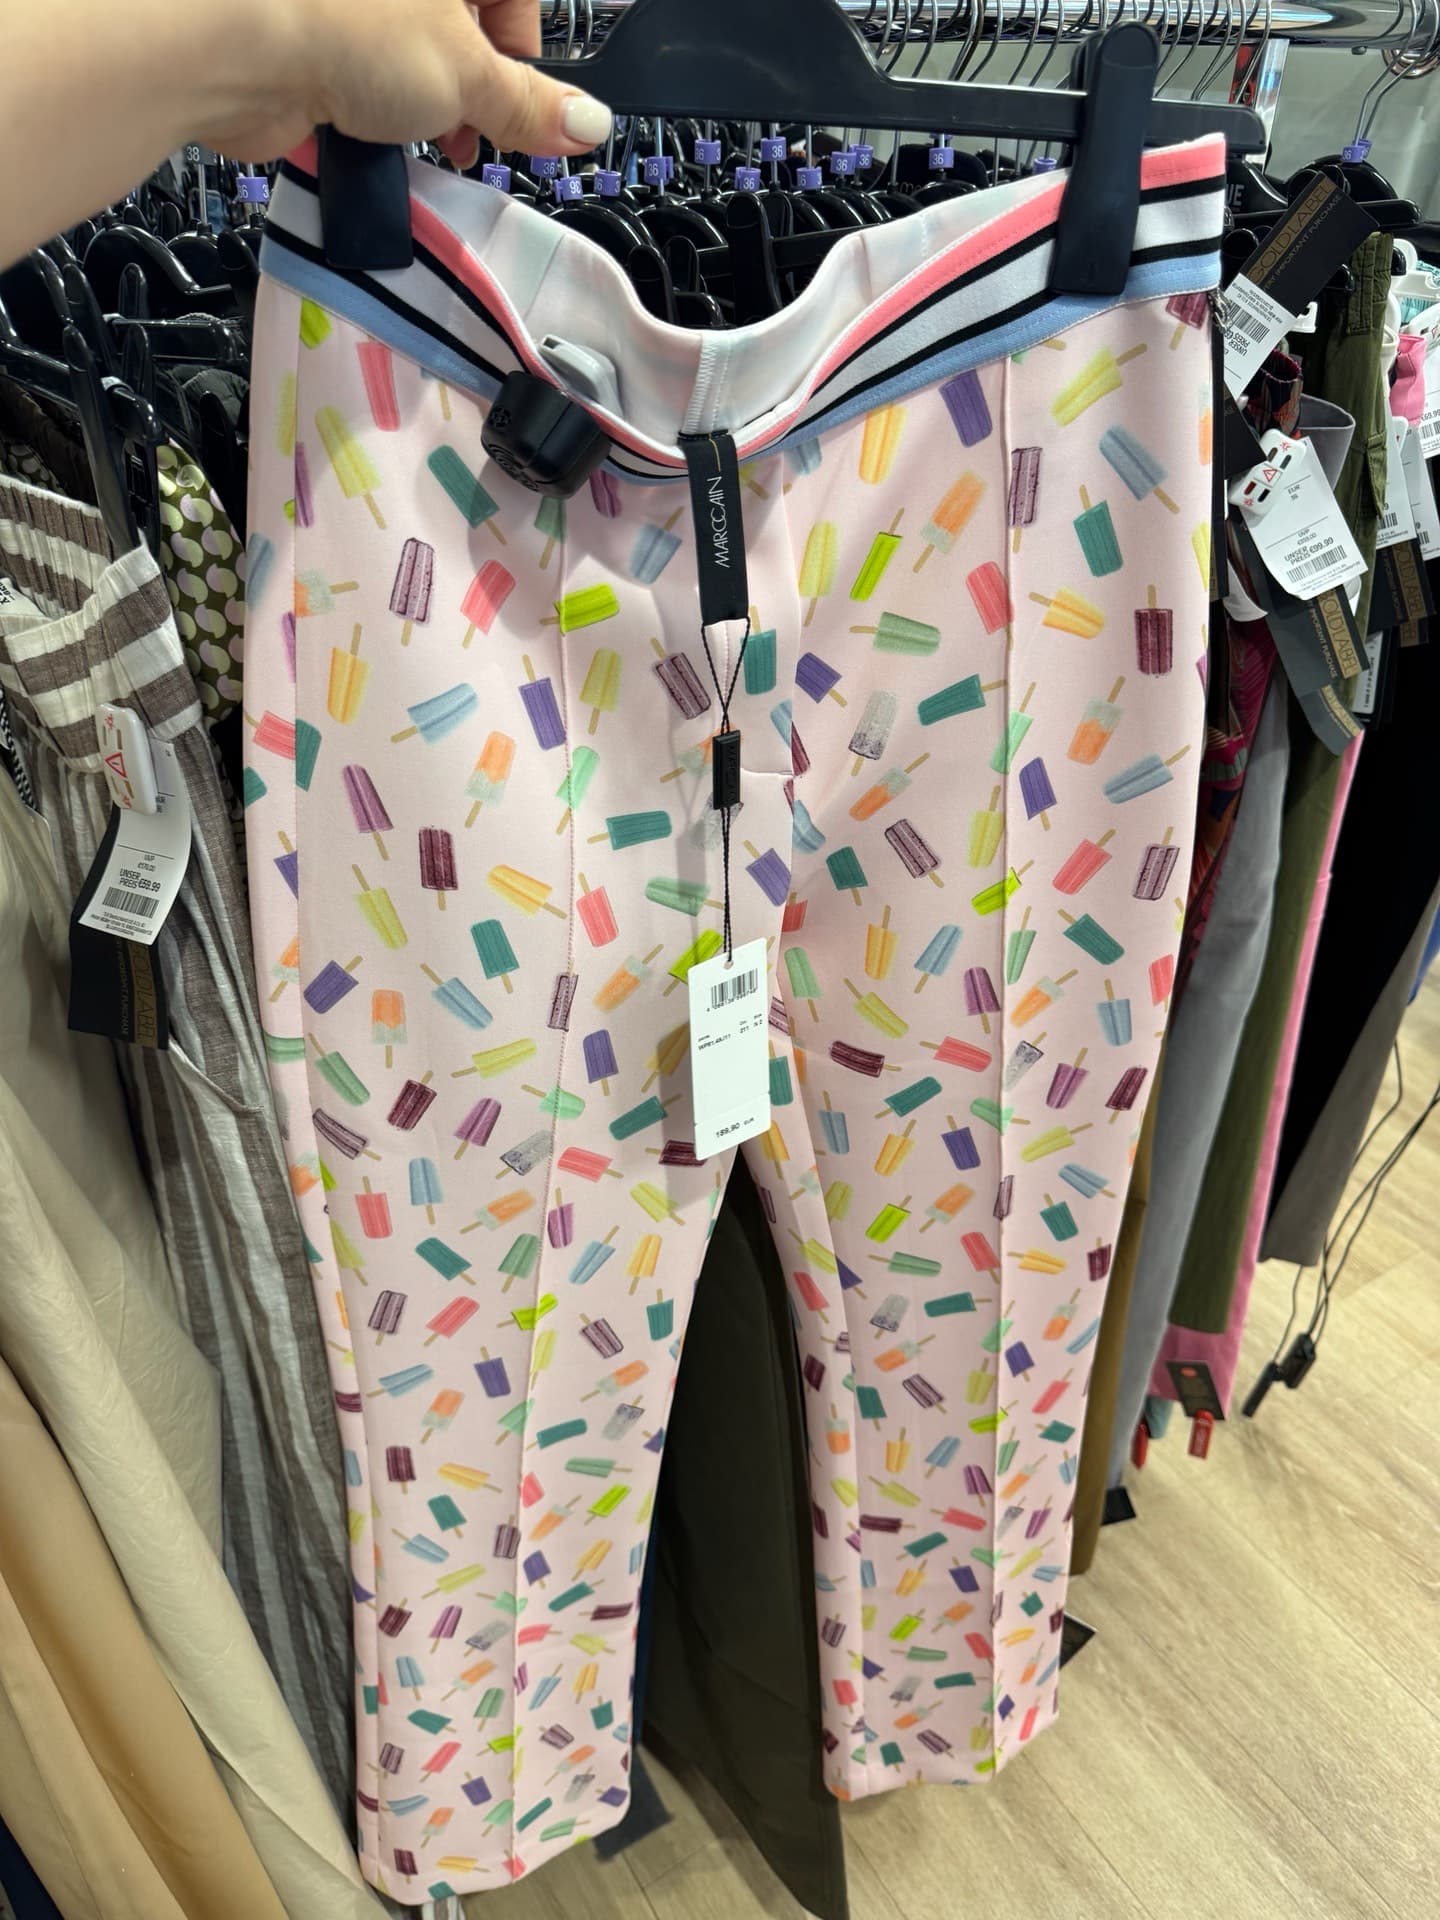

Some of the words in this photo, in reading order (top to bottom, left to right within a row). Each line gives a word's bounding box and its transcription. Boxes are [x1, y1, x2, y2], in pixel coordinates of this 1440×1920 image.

[186, 146, 200, 162] 38
[771, 144, 783, 158] 36
[836, 159, 848, 172] 36
[859, 153, 870, 166] 36
[932, 153, 944, 166] 36
[543, 162, 555, 175] 36
[648, 163, 659, 177] 36
[489, 175, 503, 188] 36
[742, 177, 754, 190] 36
[1309, 536, 1334, 554] €99.99
[1284, 545, 1308, 562] UNSER
[119, 867, 141, 881] UNSER
[118, 877, 138, 889] PREIS
[138, 878, 161, 893] €59.99
